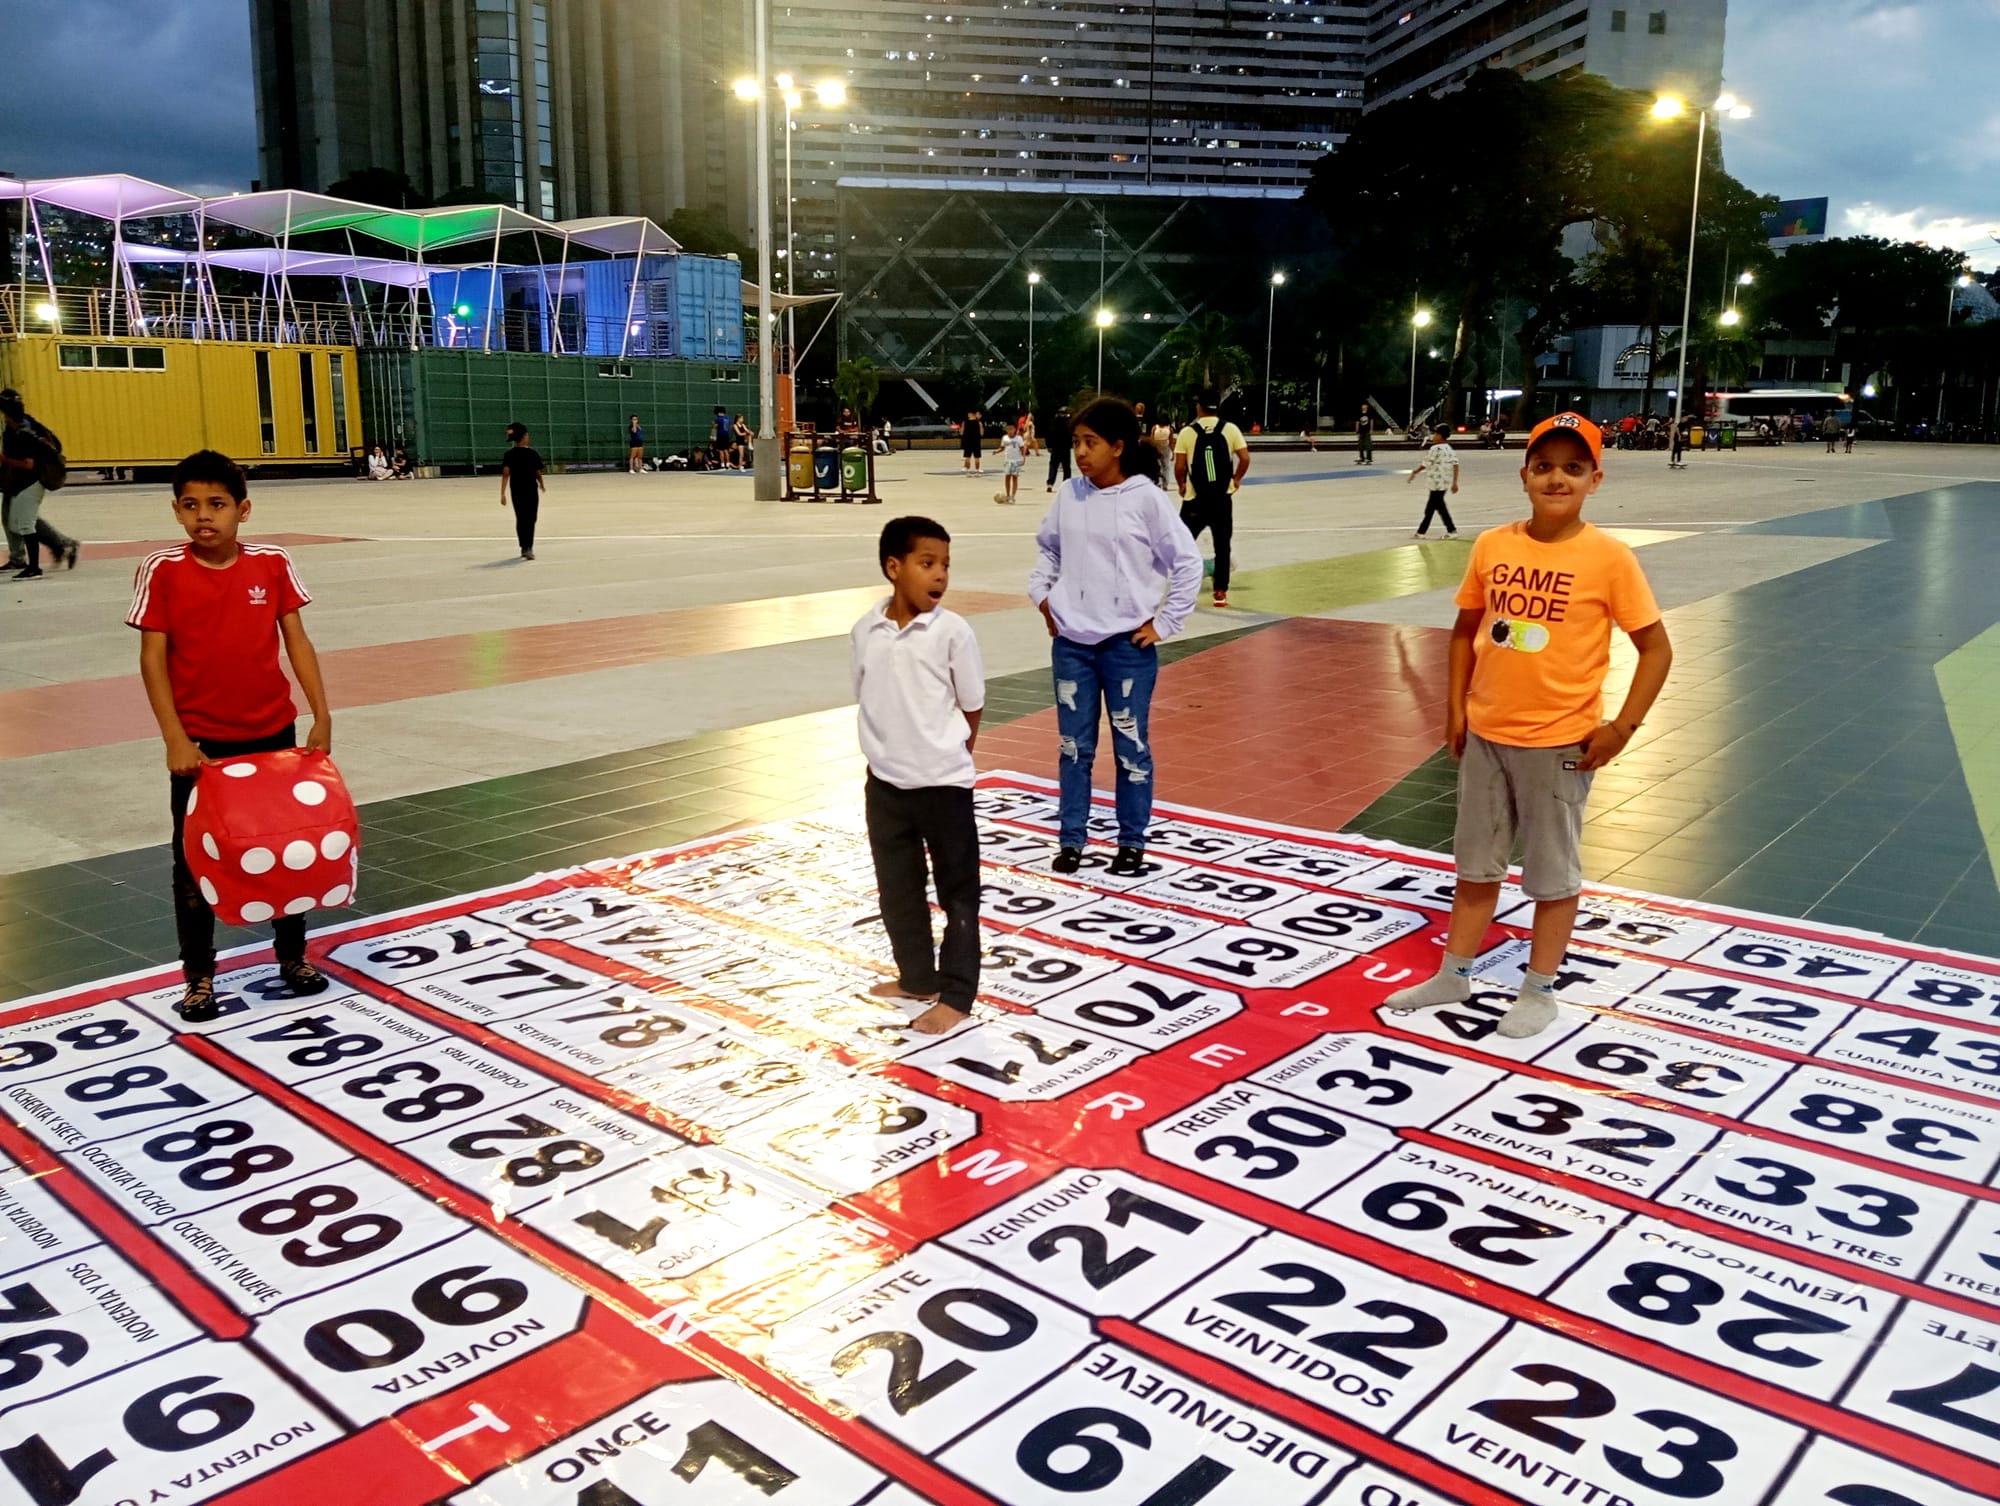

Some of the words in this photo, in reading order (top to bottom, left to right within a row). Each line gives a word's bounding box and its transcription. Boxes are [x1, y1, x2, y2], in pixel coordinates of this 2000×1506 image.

[1492, 564, 1574, 596] GAME
[1491, 589, 1568, 622] MODE
[1146, 830, 1235, 853] 53
[1244, 849, 1350, 877] 52
[1169, 873, 1277, 902] 59
[516, 897, 642, 931] 75
[1061, 911, 1176, 944] 62
[1281, 902, 1383, 936] 60
[1356, 919, 1411, 942] SESENTA
[368, 930, 508, 969] 76
[1189, 938, 1299, 977] 61
[1738, 931, 1791, 946] NUEVE
[1809, 944, 1896, 966] CUARENTA
[213, 967, 276, 985] OCHENTA
[462, 960, 588, 1000] 77
[1723, 944, 1872, 978] 49
[1920, 966, 1971, 980] OCHO
[421, 984, 464, 1004] SETENTA
[992, 982, 1040, 1001] NUEVE
[1075, 981, 1206, 1027] 70
[1658, 985, 1820, 1031] 42
[1907, 978, 2000, 1021] 8
[20, 1013, 95, 1032] OCHENTA
[375, 1013, 391, 1025] Y
[385, 1017, 431, 1043] OCHENTA
[557, 996, 687, 1048] 78
[1150, 1004, 1221, 1036] SETENTA
[1633, 1003, 1737, 1031] CUARENTA
[1744, 1027, 1760, 1037] Y
[1760, 1031, 1809, 1046] DOS
[247, 1015, 383, 1067] 84
[463, 1053, 482, 1066] Y
[514, 1023, 561, 1049] SETENTA
[568, 1049, 606, 1067] OCHO
[946, 1031, 1094, 1085] 71
[1689, 1046, 1769, 1070] TREINTA
[478, 1058, 529, 1090] OCHENTA
[1028, 1079, 1062, 1094] UNO
[1264, 1057, 1325, 1084] TREINTA
[1313, 1049, 1332, 1058] Y
[1316, 1046, 1453, 1106] 31
[1576, 1043, 1745, 1099] 39
[1815, 1077, 1876, 1095] OCHO
[1834, 1049, 1944, 1080] CUARENTA
[1951, 1075, 1966, 1083] Y
[9, 1087, 56, 1122] OCHENTA
[65, 1065, 211, 1121] 87
[342, 1061, 484, 1123] 83
[550, 1098, 578, 1115] DOS
[1904, 1097, 1996, 1125] TREINTA
[45, 1115, 62, 1127] Y
[51, 1118, 87, 1146] SIETE
[1163, 1089, 1261, 1138] TREINTA
[1491, 1094, 1676, 1168] 32
[1790, 1094, 1981, 1161] 38
[143, 1120, 294, 1191] 88
[448, 1113, 605, 1188] 82
[1194, 1106, 1347, 1181] 30
[1450, 1122, 1554, 1161] TREINTA
[1563, 1155, 1582, 1167] Y
[1584, 1163, 1648, 1189] DOS
[82, 1147, 138, 1191] OCHENTA
[126, 1181, 144, 1192] Y
[1398, 1151, 1607, 1226] VEINTINUEVE
[134, 1189, 177, 1217] OCHO
[968, 1174, 1103, 1247] VEINTIUNO
[1714, 1157, 1920, 1238] 33
[6, 1207, 63, 1250] NOVENTA
[173, 1221, 229, 1267] OCHENTA
[238, 1184, 404, 1268] 89
[1027, 1186, 1206, 1292] 21
[1362, 1181, 1574, 1267] 29
[1680, 1192, 1794, 1236] TREINTA
[1805, 1230, 1824, 1242] Y
[1831, 1239, 1904, 1268] TRES
[66, 1262, 103, 1288] DOS
[219, 1259, 240, 1272] Y
[227, 1266, 282, 1304] NUEVE
[1638, 1232, 1870, 1313] VEINTIOCHO
[86, 1281, 110, 1295] Y
[98, 1289, 160, 1344] NOVENTA
[303, 1265, 529, 1373] 90
[1212, 1262, 1448, 1380] 22
[1607, 1261, 1851, 1368] 28
[372, 1318, 546, 1395] NOVENTA
[829, 1288, 1040, 1418] 20
[1184, 1306, 1396, 1409] VEINTIDOS
[1083, 1352, 1330, 1480] DIECINUEVE
[1466, 1363, 1740, 1499] 23
[0, 1374, 256, 1506] 91
[169, 1420, 317, 1491] NOVENTA
[545, 1411, 672, 1484] ONCE
[148, 1489, 169, 1503] Y
